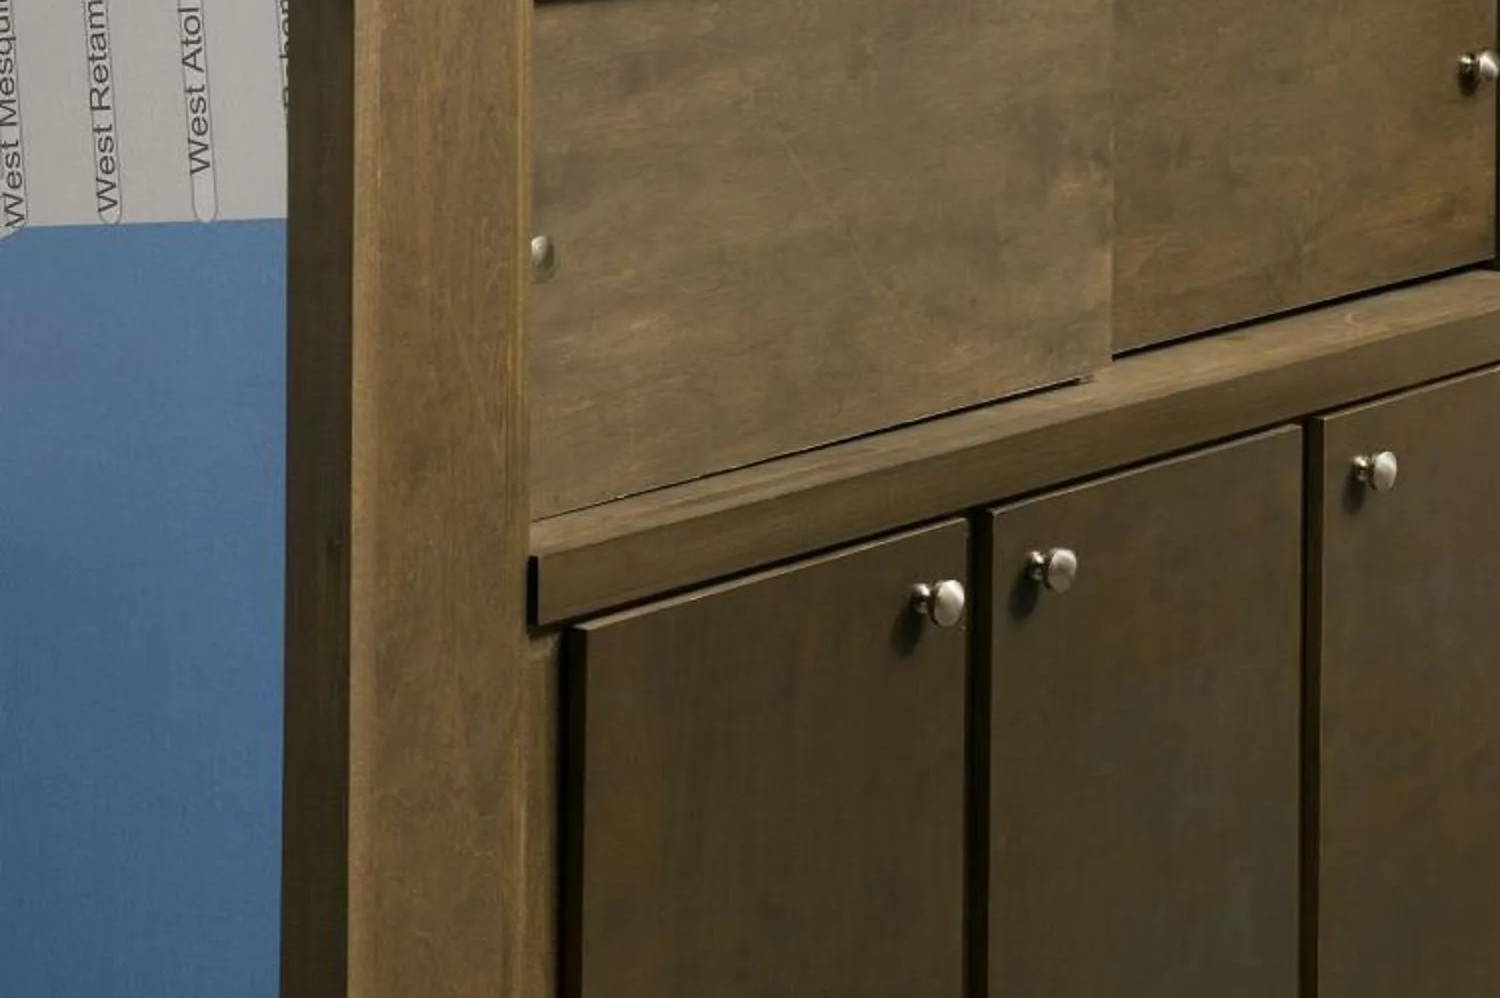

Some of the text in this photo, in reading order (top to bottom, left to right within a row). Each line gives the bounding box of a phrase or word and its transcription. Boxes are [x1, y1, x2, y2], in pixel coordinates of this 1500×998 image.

[180, 7, 205, 72] Atol
[96, 122, 119, 213] West
[188, 83, 211, 174] West
[1, 139, 25, 228] West
